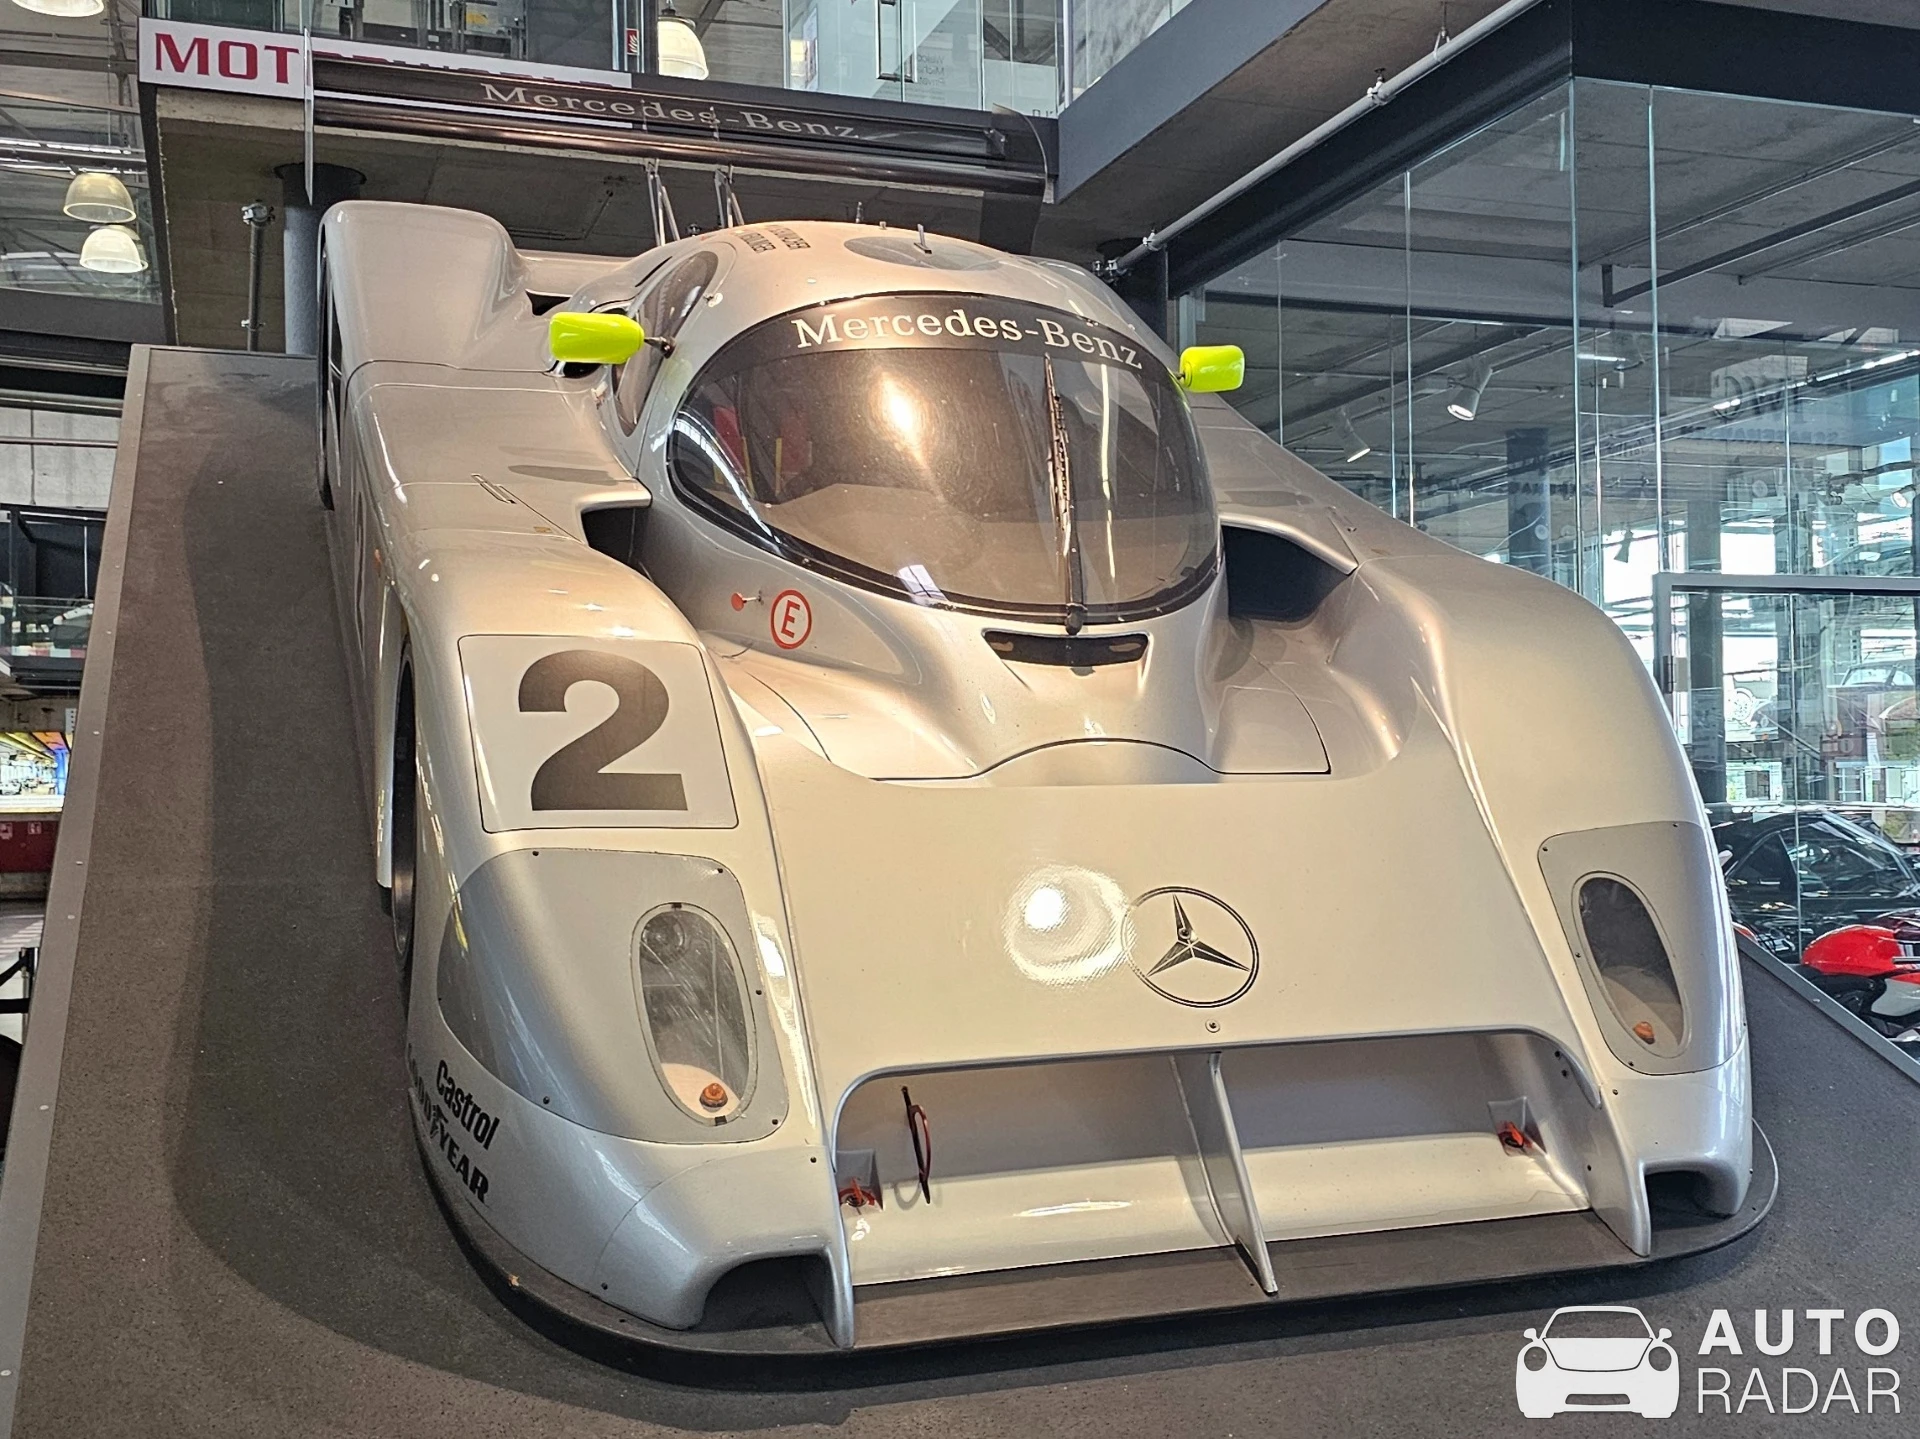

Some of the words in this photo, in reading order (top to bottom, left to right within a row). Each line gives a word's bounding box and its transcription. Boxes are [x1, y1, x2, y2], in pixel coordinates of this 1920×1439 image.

[155, 33, 299, 84] MOT
[480, 83, 859, 138] Mercedes-Benz
[791, 309, 1143, 370] Mercedes-Benz
[781, 600, 800, 638] E
[518, 650, 688, 811] 2
[436, 1059, 500, 1150] Castrol
